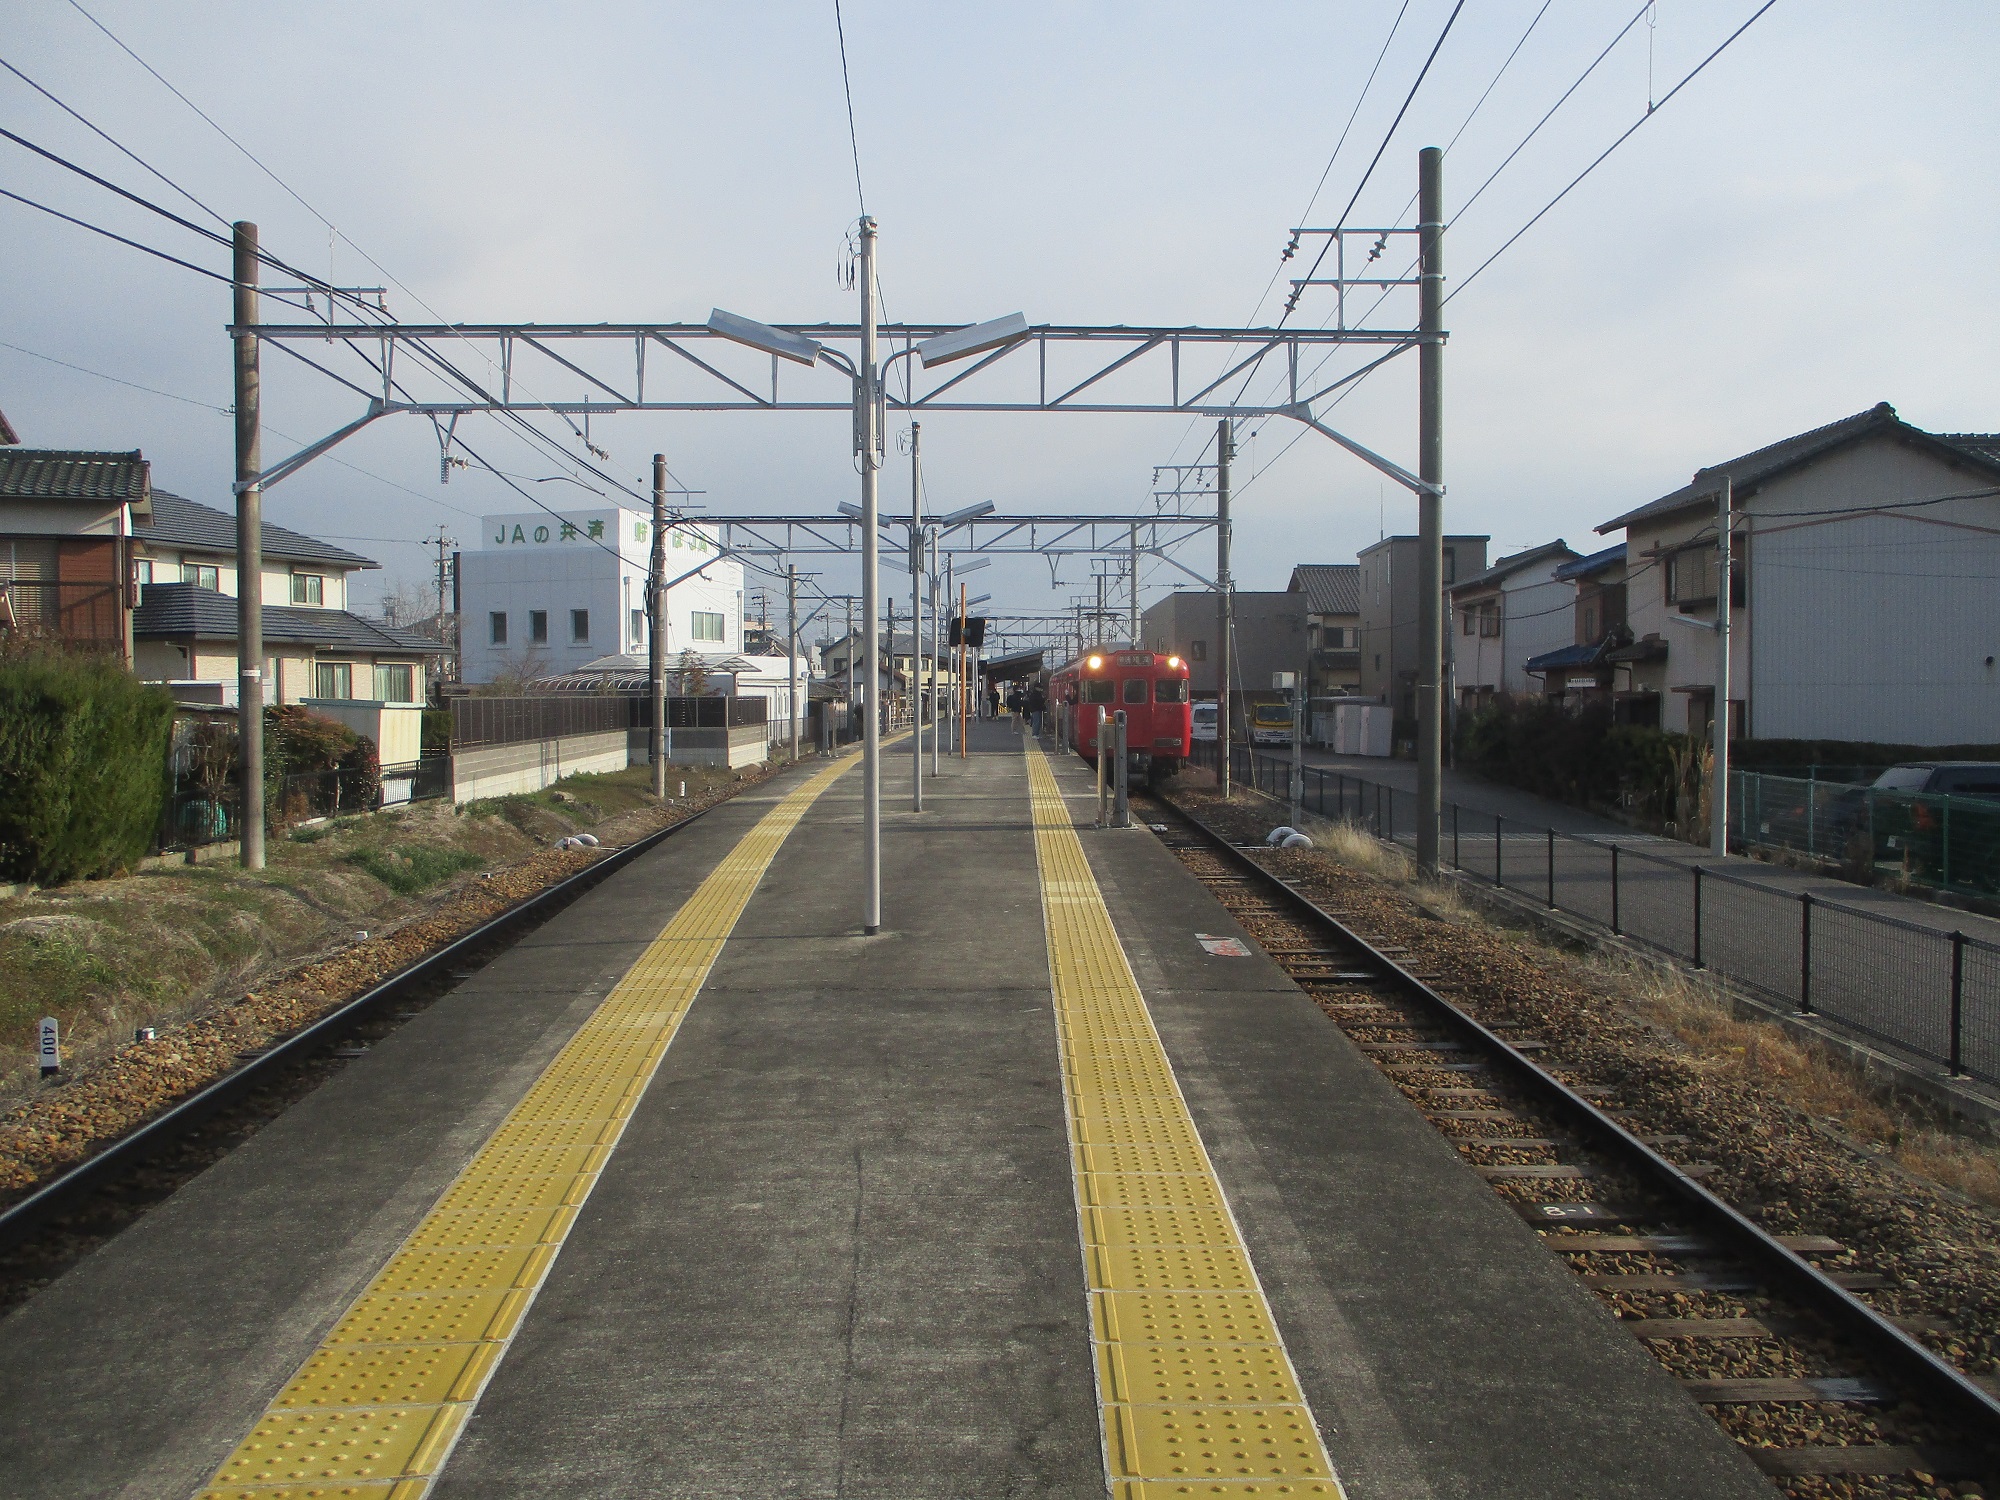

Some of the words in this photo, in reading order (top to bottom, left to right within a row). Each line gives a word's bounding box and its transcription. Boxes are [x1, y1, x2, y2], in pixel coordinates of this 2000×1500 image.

[495, 518, 604, 544] JAの共済
[634, 521, 708, 552] 貯はJA
[42, 1026, 56, 1055] 400
[1543, 1206, 1593, 1216] 8-1
